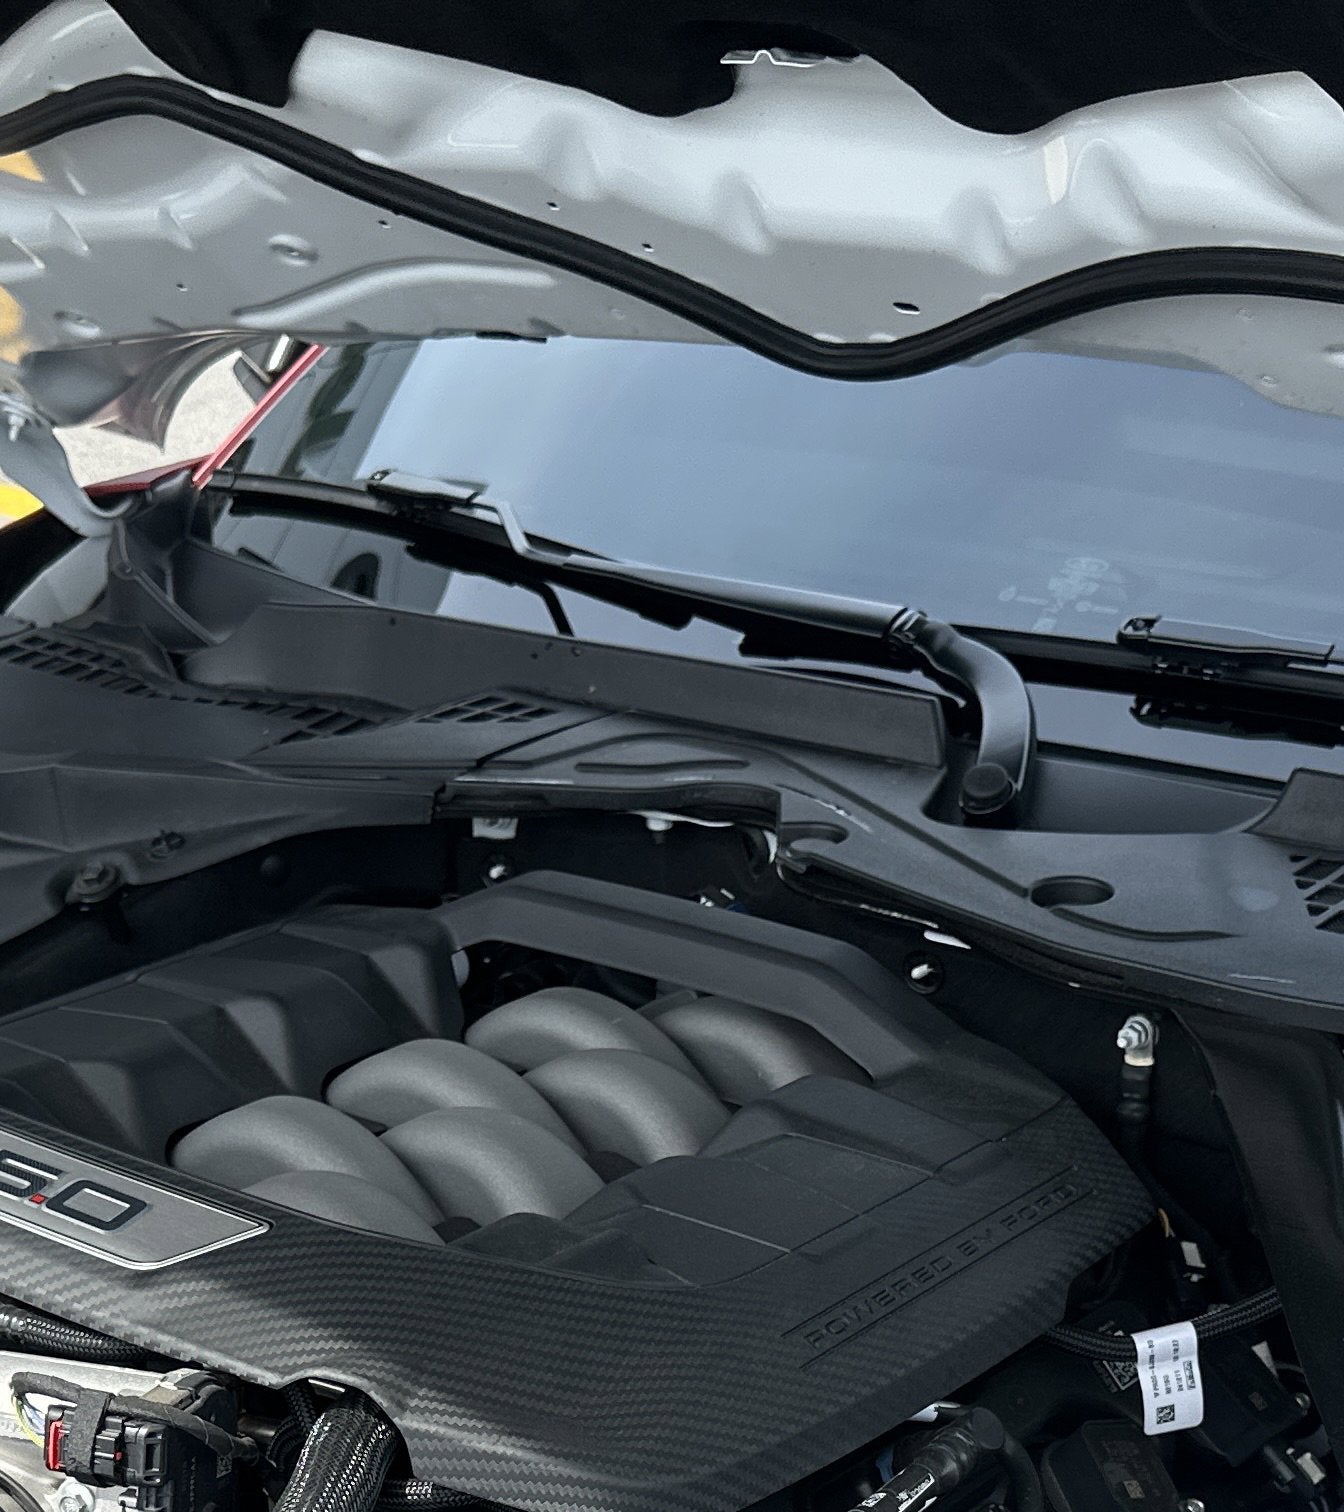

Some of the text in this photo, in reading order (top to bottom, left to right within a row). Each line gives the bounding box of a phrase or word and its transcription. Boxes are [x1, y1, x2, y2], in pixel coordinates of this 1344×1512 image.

[803, 1184, 1077, 1349] POWERED BY FORD
